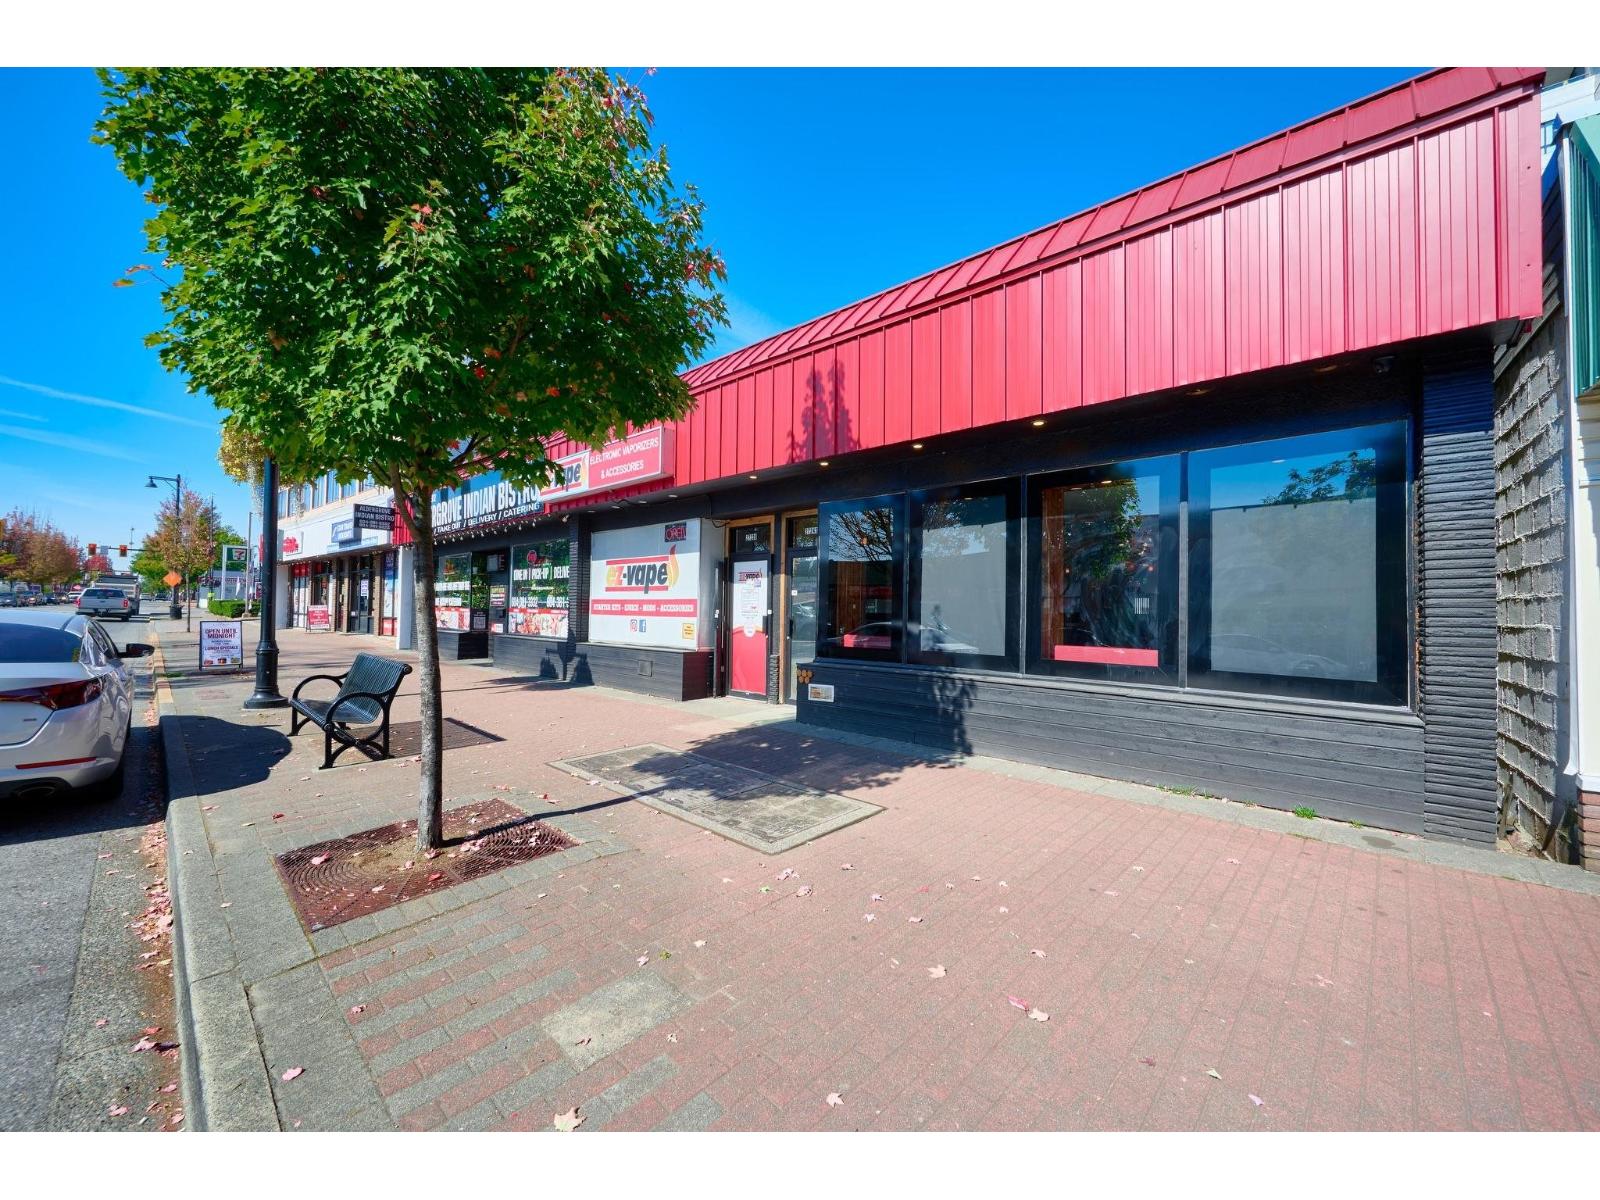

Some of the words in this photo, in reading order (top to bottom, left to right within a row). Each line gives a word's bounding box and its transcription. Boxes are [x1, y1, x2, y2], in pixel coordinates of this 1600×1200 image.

[589, 447, 621, 465] ELECTRONIC
[622, 437, 659, 456] VAPORIZERS
[605, 460, 644, 477] ACCESSORIES
[463, 485, 496, 519] INDIAN
[437, 525, 451, 533] TAKE
[467, 512, 497, 526] DELIVERY
[503, 502, 540, 518] CATERING
